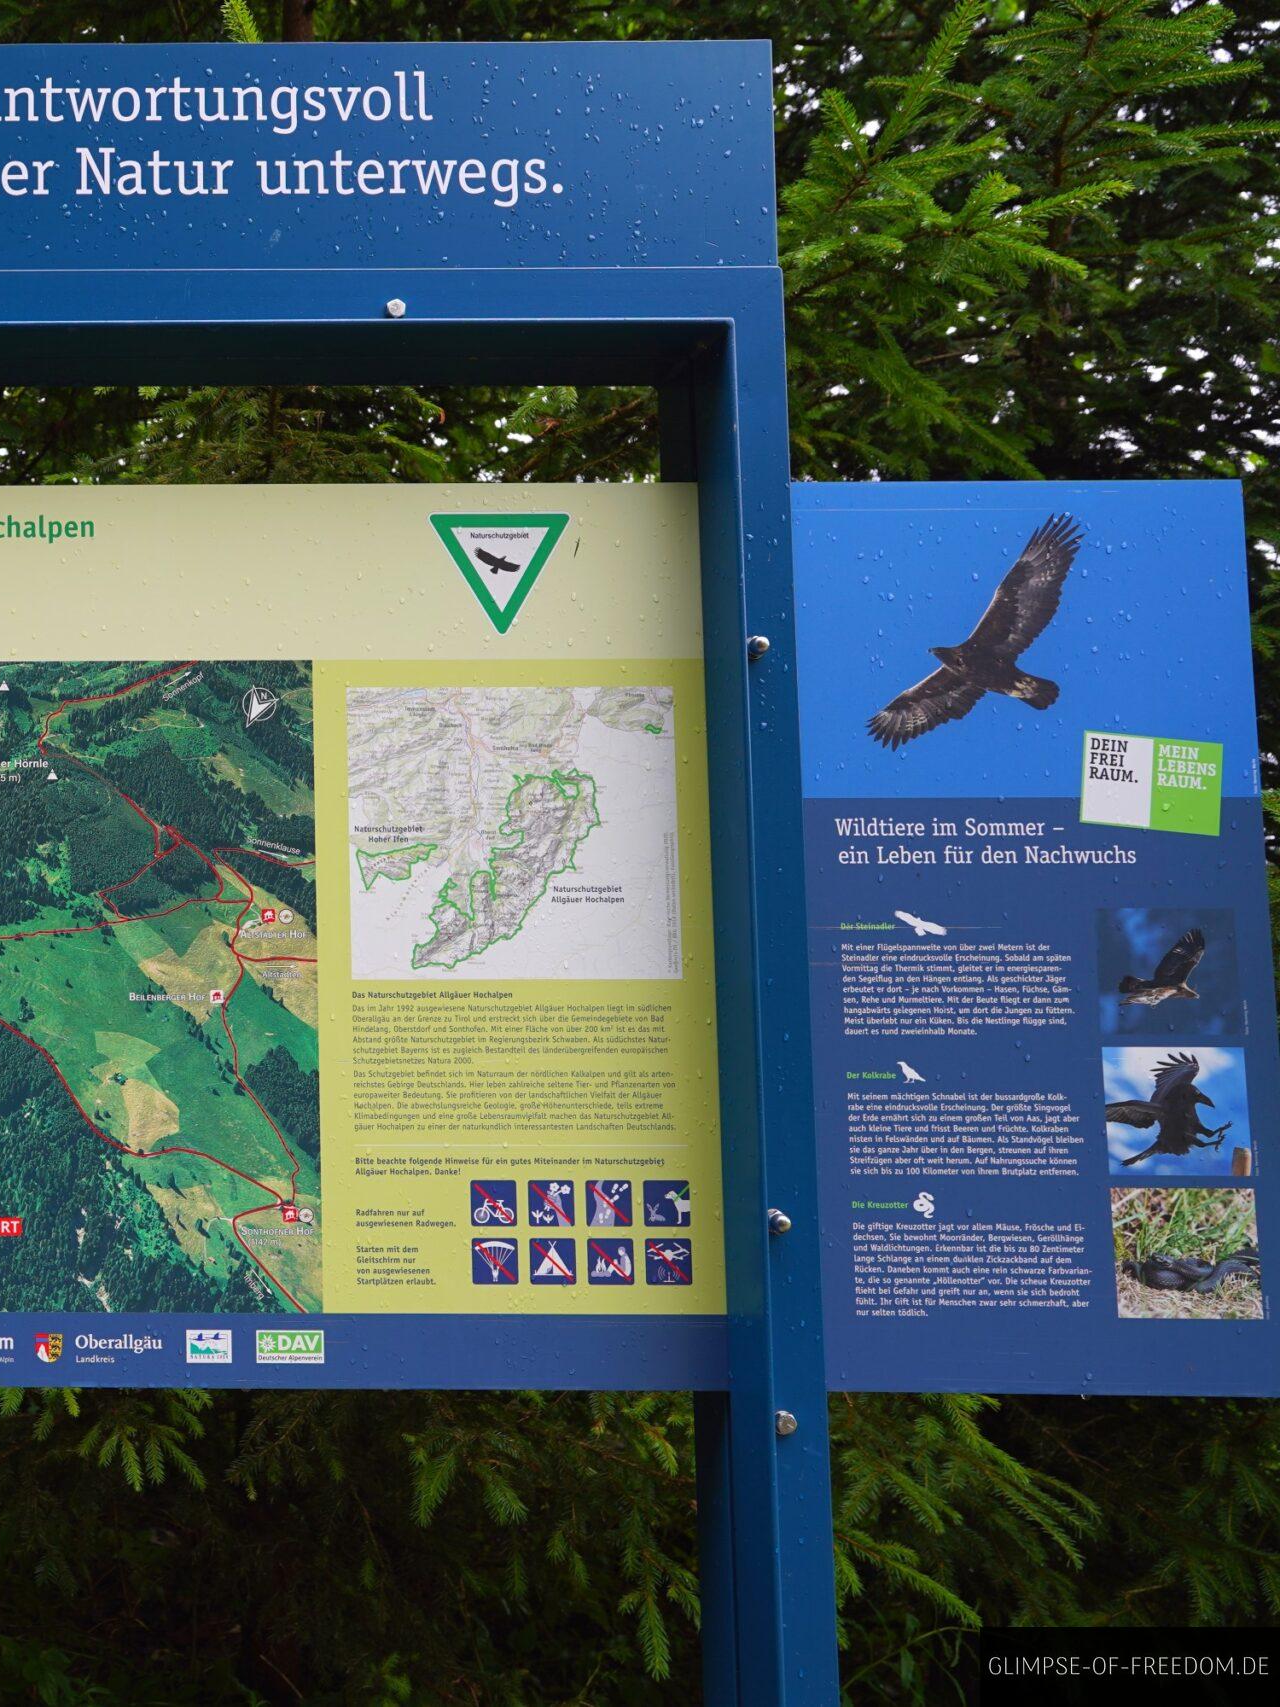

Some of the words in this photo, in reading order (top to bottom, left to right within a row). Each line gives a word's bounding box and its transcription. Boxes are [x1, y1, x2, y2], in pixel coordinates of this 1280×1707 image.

[76, 147, 233, 195] Natur
[257, 147, 563, 207] unterwegs.
[470, 532, 529, 540] Naturschutzgebiet
[162, 671, 204, 702] Sonnenkopf
[261, 692, 267, 700] N
[1091, 738, 1129, 753] DEIN
[1159, 744, 1199, 759] MEIN
[14, 759, 48, 768] Hörnle
[1090, 752, 1124, 767] FREI
[1158, 759, 1216, 777] LEBENS
[8, 774, 21, 783] m)
[1089, 767, 1138, 784] RAUM.
[1157, 773, 1207, 791] RAUM.
[353, 824, 425, 836] Naturschutzgebiet
[835, 817, 925, 836] Wildtiere
[932, 817, 957, 836] im
[965, 818, 1045, 836] Sommer
[368, 834, 393, 843] Hoher
[393, 834, 411, 843] Ifen
[246, 836, 301, 855] Sonnenklause
[839, 845, 869, 864] ein
[877, 845, 936, 864] Leben
[944, 845, 973, 864] für
[981, 845, 1018, 864] den
[1025, 845, 1136, 864] Nachwuchs
[553, 885, 622, 895] Naturschutzgebiet
[551, 896, 583, 905] Allgäuer
[585, 896, 625, 904] Hochalpen
[841, 943, 853, 951] Mit
[877, 943, 941, 953] Flügelspannweite
[959, 943, 976, 951] über
[998, 943, 1024, 951] Metern
[1026, 943, 1036, 951] ist
[352, 991, 366, 999] Das
[368, 991, 437, 1001] Naturschutzgebiet
[439, 991, 471, 1000] Allgäuer
[473, 991, 513, 1000] Hochalpen
[847, 1071, 861, 1081] Der
[862, 1072, 896, 1081] Kolkrabe
[852, 1201, 867, 1209] Die
[868, 1201, 908, 1209] Kreuzotter
[356, 1221, 413, 1229] ausgewiesenen
[416, 1219, 456, 1229] Radwegen.
[75, 1333, 162, 1354] Oberallgäu
[278, 1335, 319, 1351] DAV
[76, 1355, 115, 1363] Landkreis
